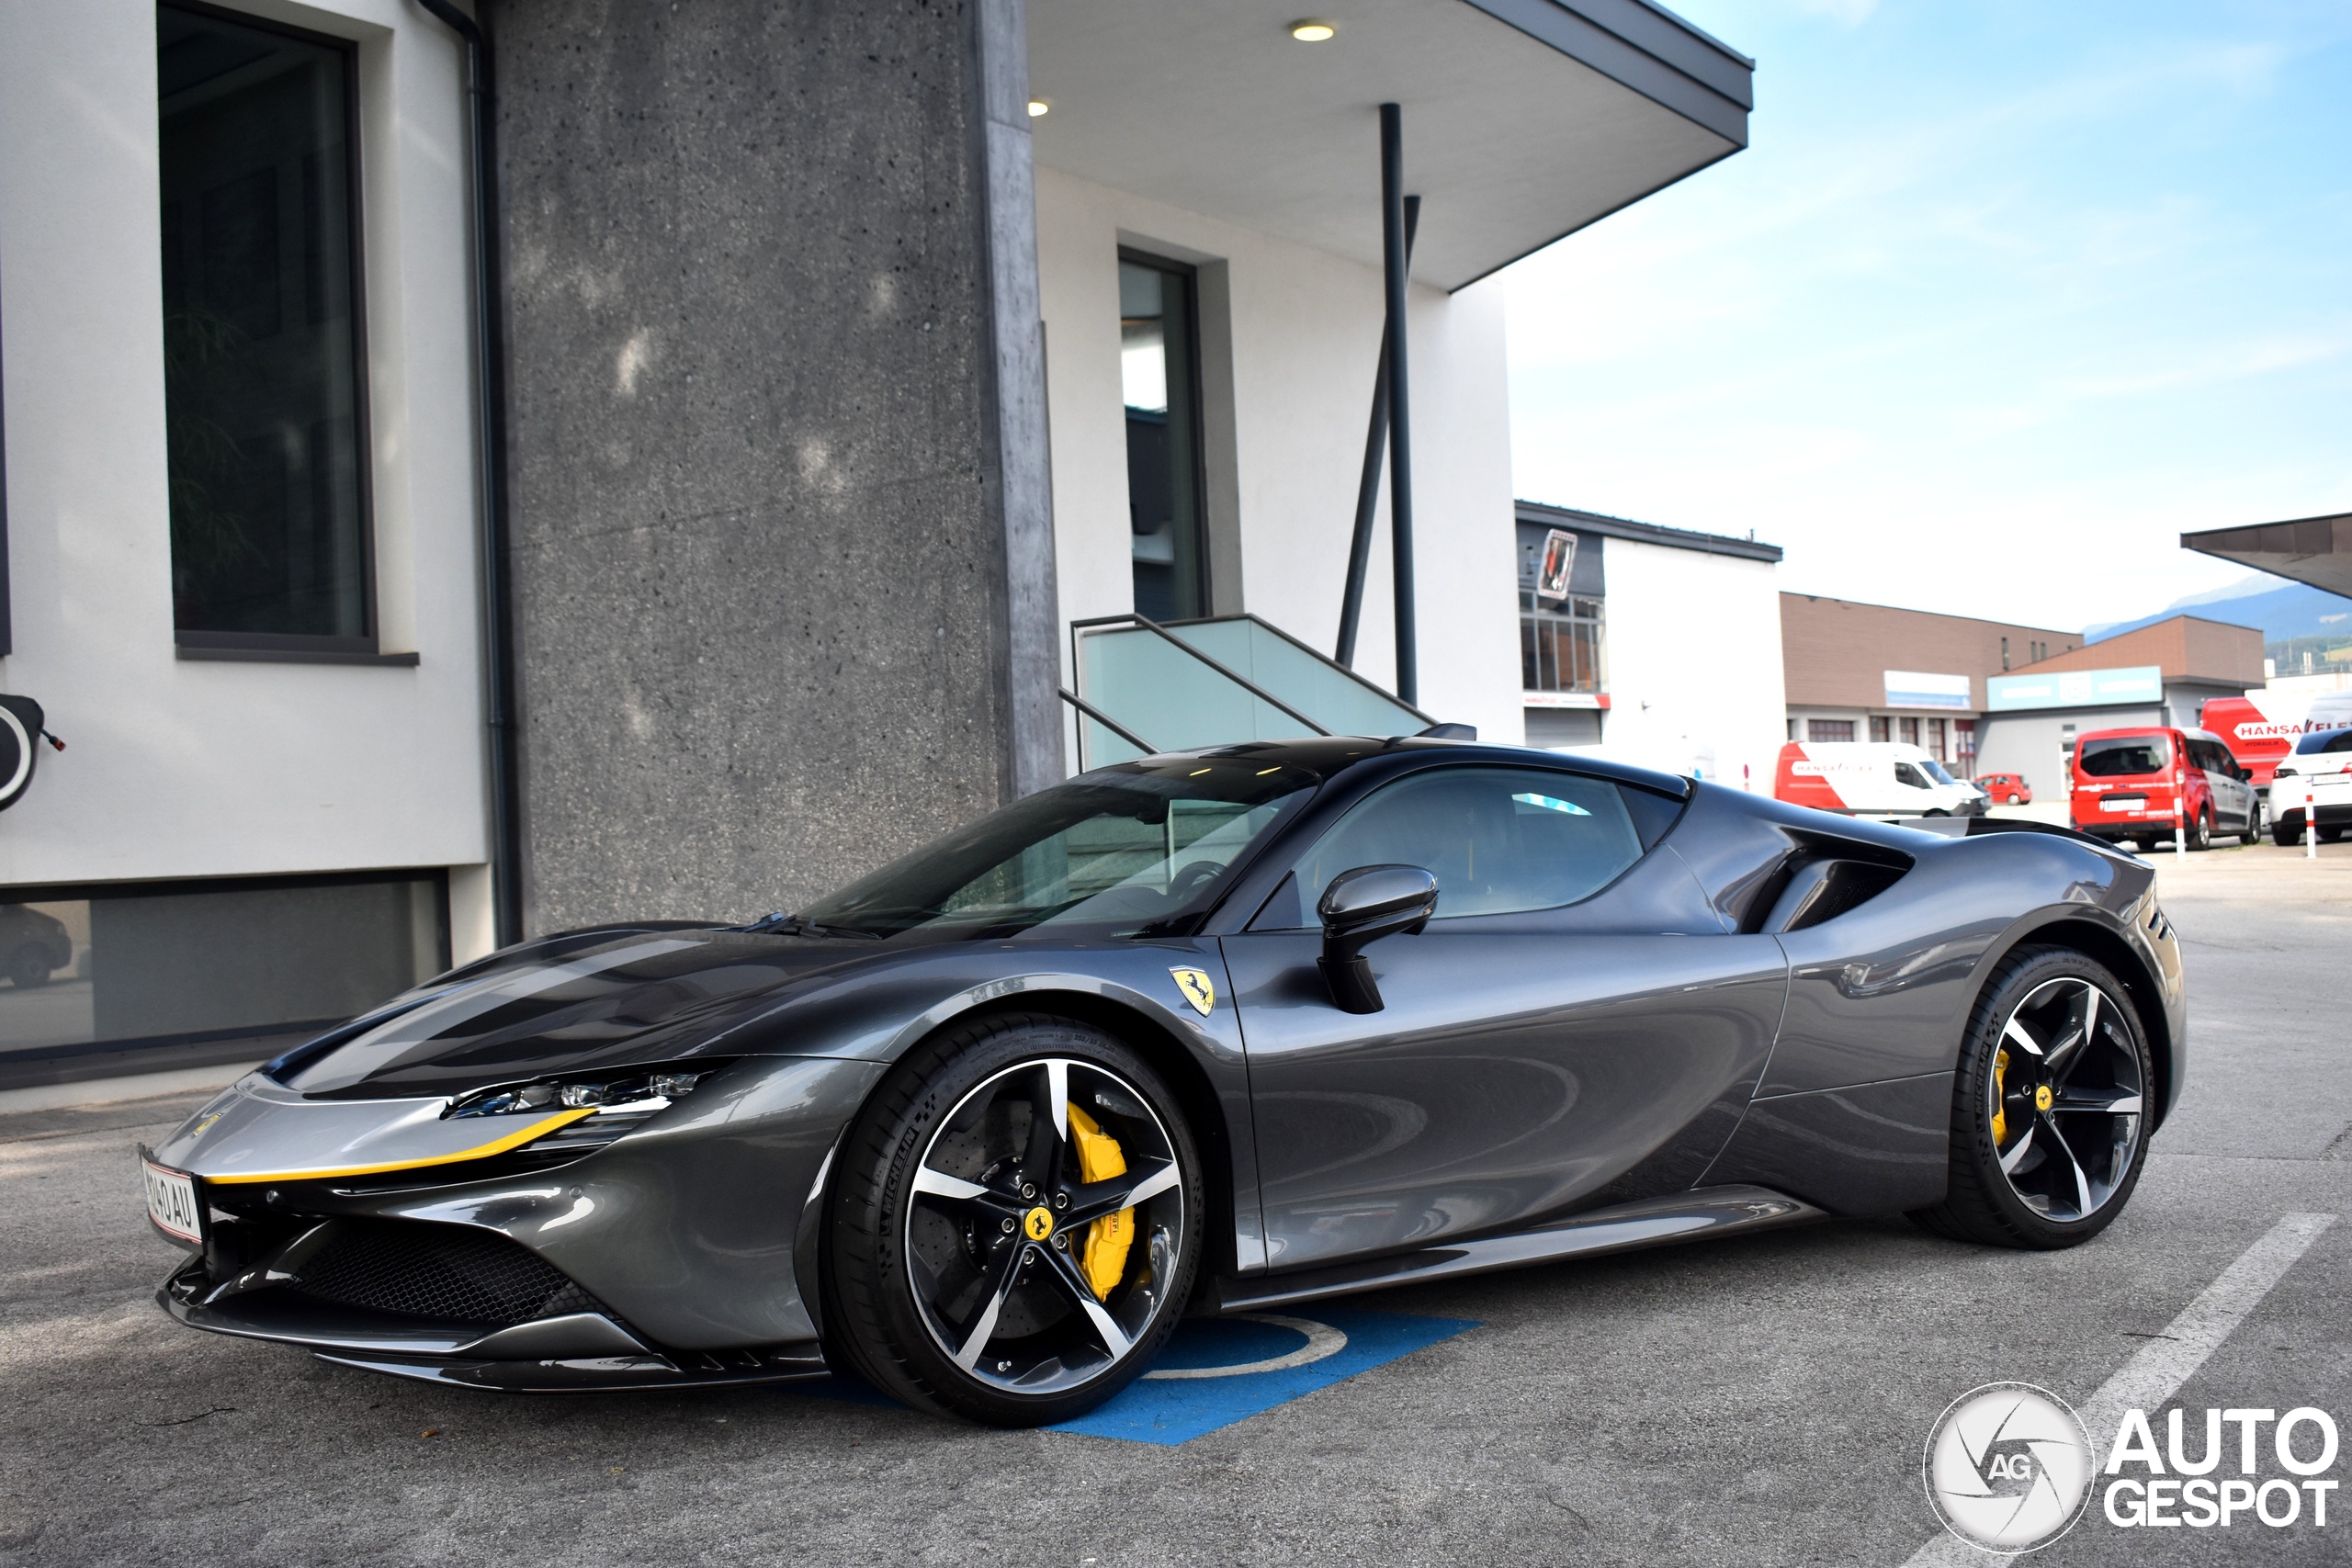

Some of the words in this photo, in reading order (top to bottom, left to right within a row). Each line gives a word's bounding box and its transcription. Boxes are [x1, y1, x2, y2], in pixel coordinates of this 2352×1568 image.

[2241, 725, 2302, 736] HANSA
[2315, 721, 2352, 732] FLE
[1974, 1043, 1990, 1114] MICHELIN
[882, 1128, 917, 1215] MICHELIN
[172, 1182, 192, 1228] AU
